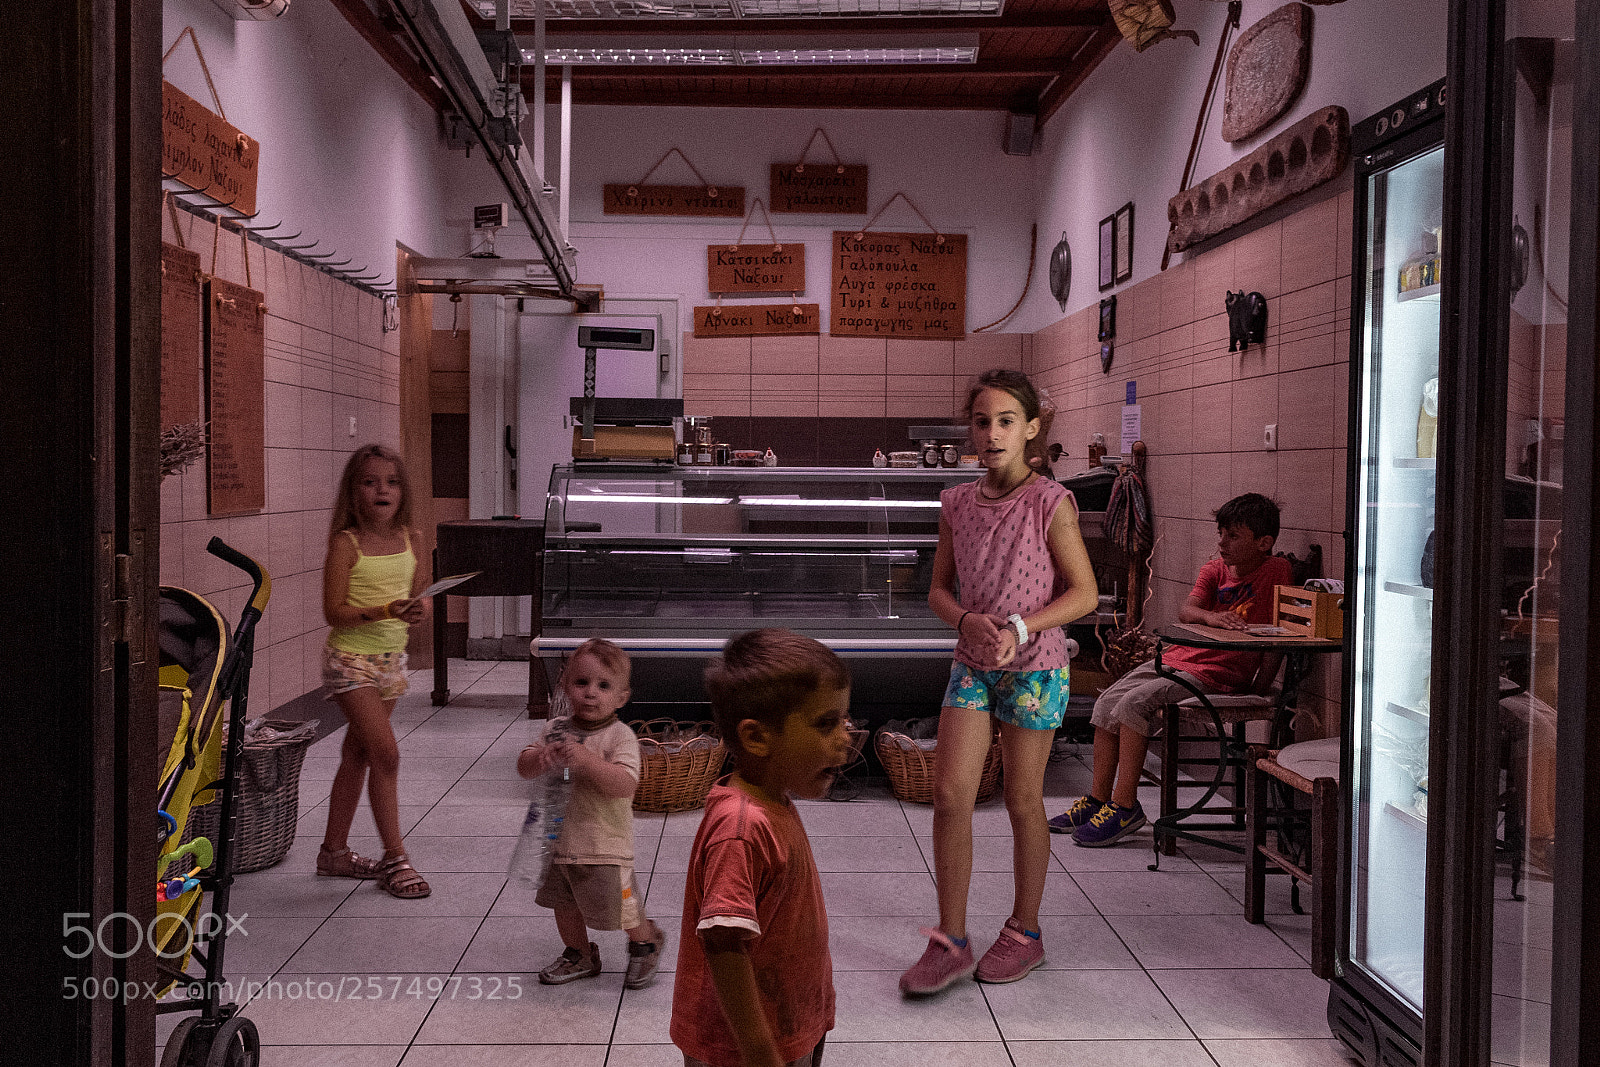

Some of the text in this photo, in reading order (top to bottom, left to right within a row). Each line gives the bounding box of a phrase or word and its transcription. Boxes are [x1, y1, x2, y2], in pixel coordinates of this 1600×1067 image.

[162, 98, 197, 144] λάδες
[733, 267, 784, 288] Νάξου!
[839, 275, 875, 293] Αυγά
[839, 292, 957, 313] Τυρί & μυζήθρα
[839, 313, 913, 332] παραγωγής
